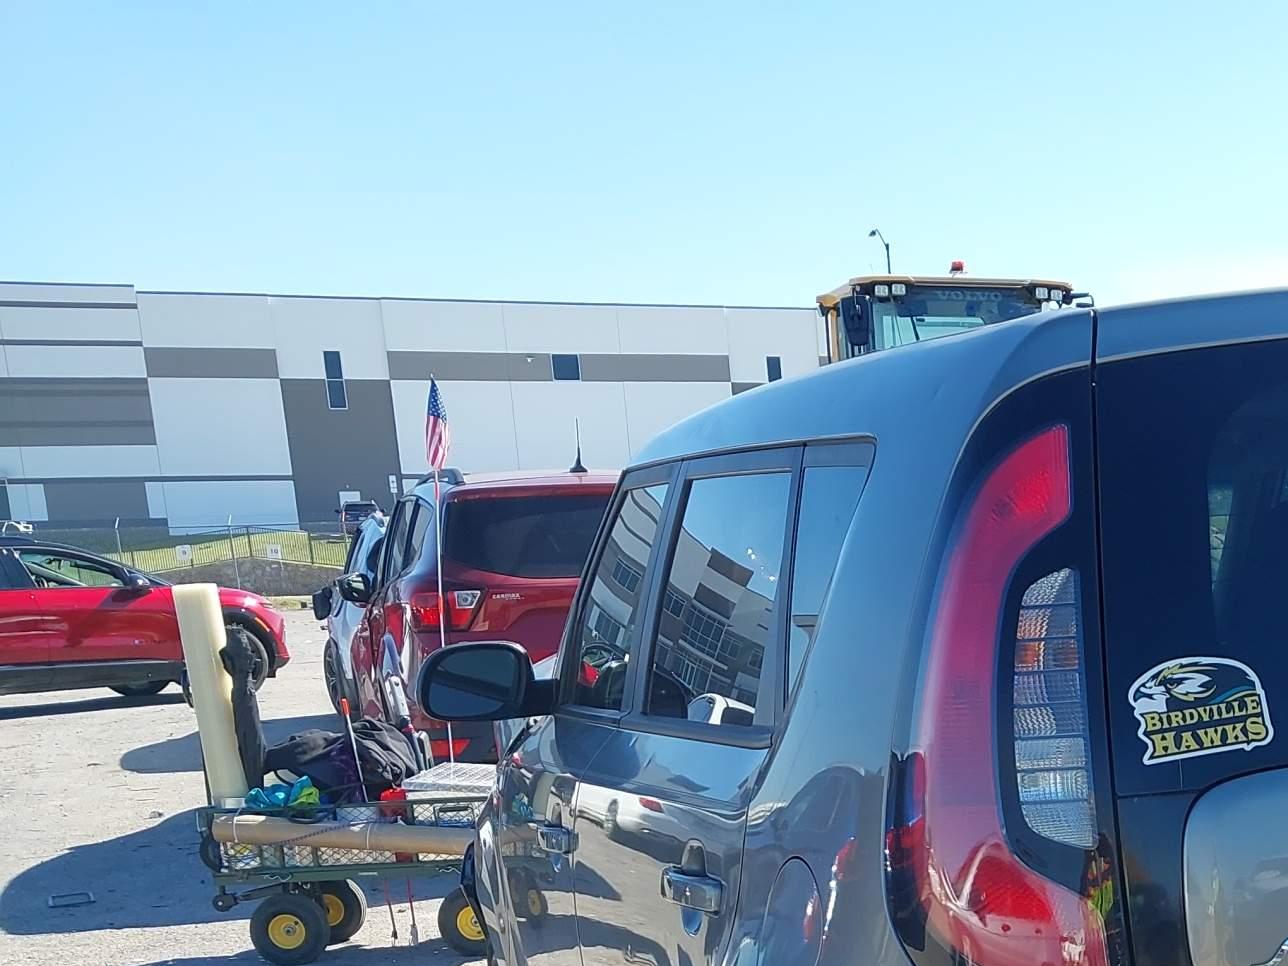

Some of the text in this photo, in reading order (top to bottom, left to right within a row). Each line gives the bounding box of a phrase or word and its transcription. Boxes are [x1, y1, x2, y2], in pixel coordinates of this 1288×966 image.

[936, 290, 1003, 301] VOLVO
[1144, 696, 1261, 732] BIRDVILLE
[1150, 717, 1266, 757] HAWKS
